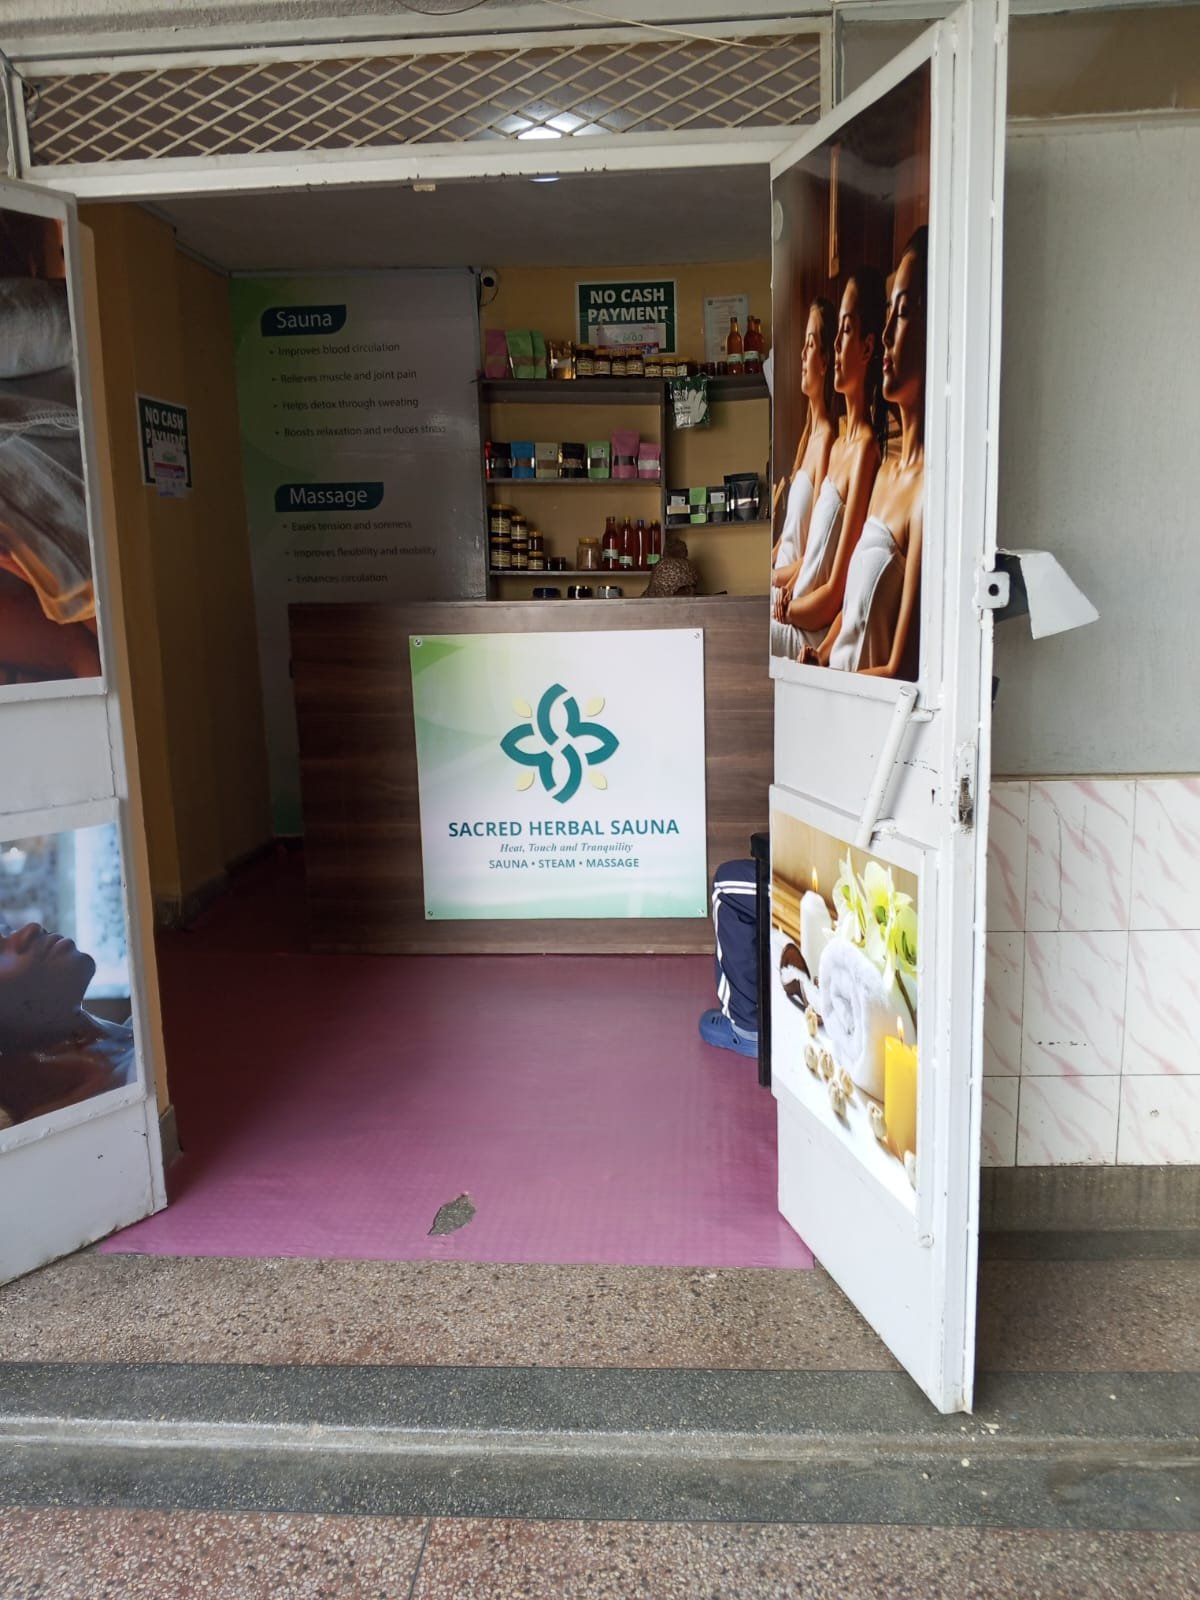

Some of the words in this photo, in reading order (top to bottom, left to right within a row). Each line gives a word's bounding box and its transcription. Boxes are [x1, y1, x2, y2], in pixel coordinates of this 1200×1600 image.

[590, 290, 616, 304] NO
[620, 288, 665, 302] CASH
[276, 311, 333, 329] Sauna
[588, 305, 668, 323] PAYMENT
[278, 346, 321, 357] Improves
[323, 344, 350, 354] blood
[352, 343, 400, 353] circulation
[281, 373, 317, 384] Relieves
[319, 372, 352, 382] muscle
[354, 371, 372, 381] and
[373, 370, 394, 383] joint
[396, 370, 417, 383] pain
[282, 400, 309, 411] Helps
[310, 399, 336, 409] detox
[338, 398, 376, 410] through
[378, 397, 419, 409] sweating
[145, 405, 159, 424] NO
[161, 410, 184, 429] CASH
[284, 428, 314, 437] Boosts
[316, 427, 364, 437] relaxation
[365, 426, 381, 435] and
[383, 425, 418, 435] reduces
[289, 487, 368, 507] Massage
[291, 522, 317, 532] Eases
[318, 521, 352, 530] tension
[353, 520, 371, 530] and
[373, 520, 412, 530] soreness
[294, 547, 336, 558] Improves
[337, 546, 378, 558] flexibility
[380, 546, 398, 556] and
[448, 821, 522, 837] SACRED
[529, 820, 605, 836] HERBAL
[610, 819, 680, 835] SAUNA
[500, 843, 525, 853] Heat,
[529, 842, 557, 852] Touch
[560, 842, 578, 852] and
[581, 842, 634, 854] Tranquility
[489, 859, 528, 869] SAUNA
[538, 858, 576, 868] STEAM
[586, 858, 639, 868] MASSAGE
